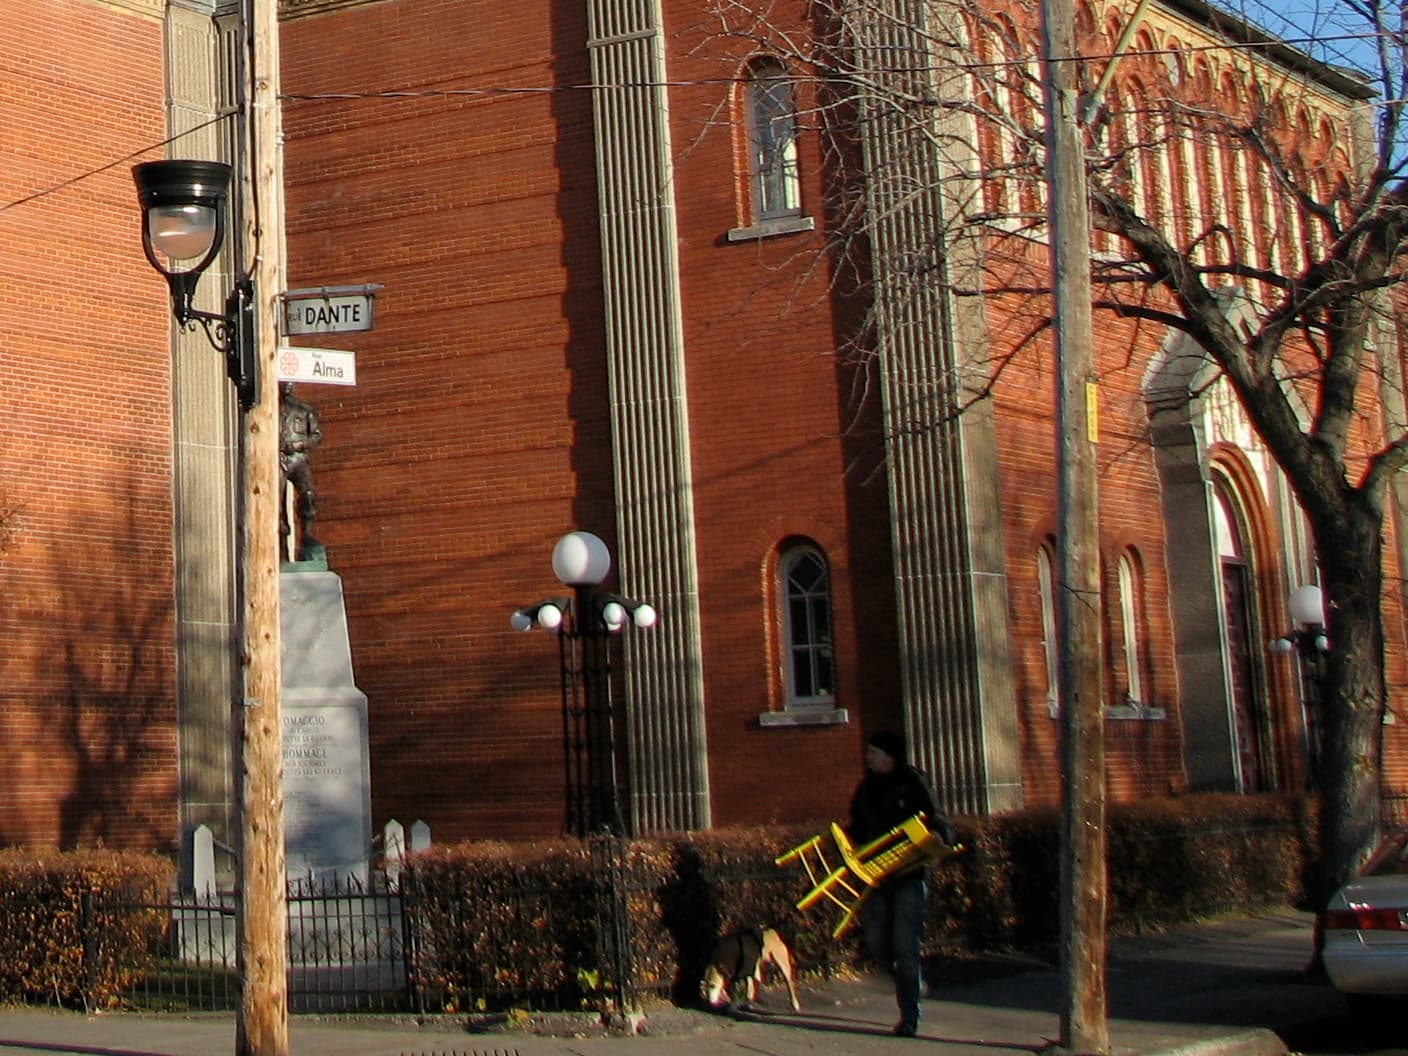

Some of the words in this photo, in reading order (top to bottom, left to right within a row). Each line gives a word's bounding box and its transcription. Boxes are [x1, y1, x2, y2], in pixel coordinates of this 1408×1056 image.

[305, 304, 360, 325] DANTE
[312, 361, 344, 378] Alma
[283, 716, 325, 726] OMAGGIO
[282, 748, 327, 759] HOMMAGE
